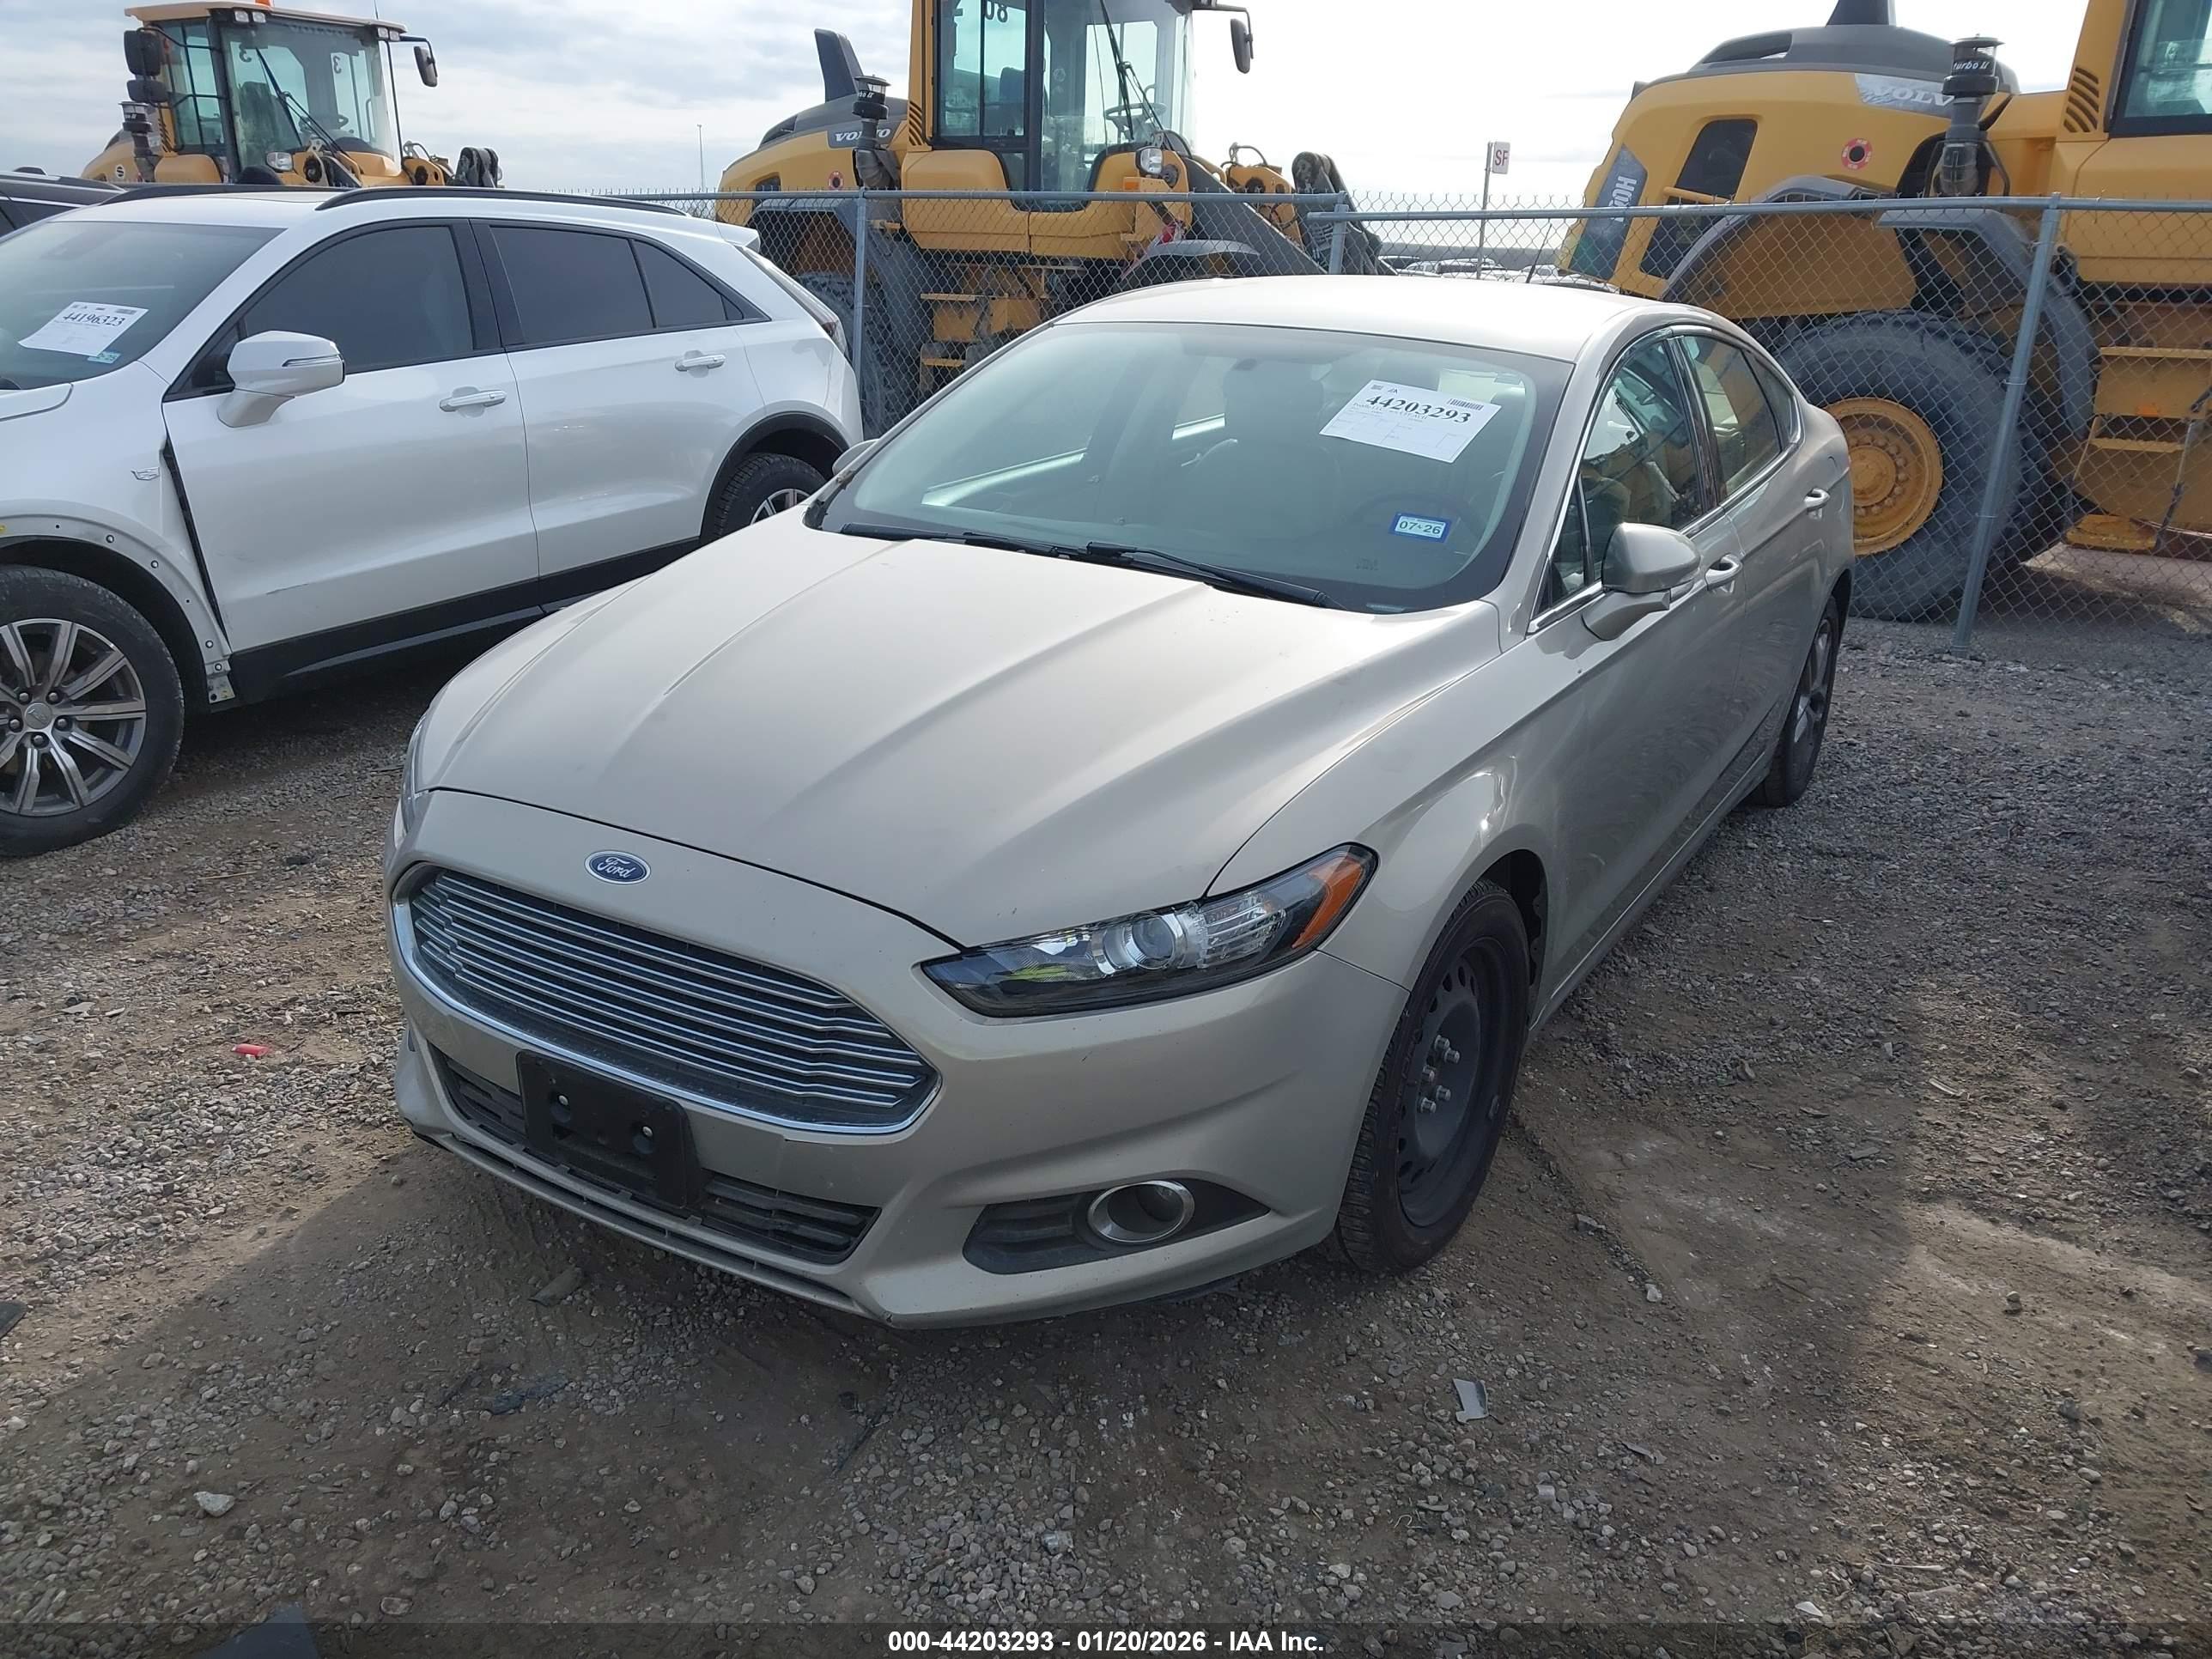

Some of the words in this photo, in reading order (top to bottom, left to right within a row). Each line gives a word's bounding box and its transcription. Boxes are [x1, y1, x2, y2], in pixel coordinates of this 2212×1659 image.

[1953, 60, 1978, 70] turbo
[1872, 86, 1955, 106] VOLV
[1494, 149, 1509, 166] SF
[62, 312, 126, 327] 44196323
[1365, 395, 1472, 423] 44203293
[597, 856, 636, 878] Ford
